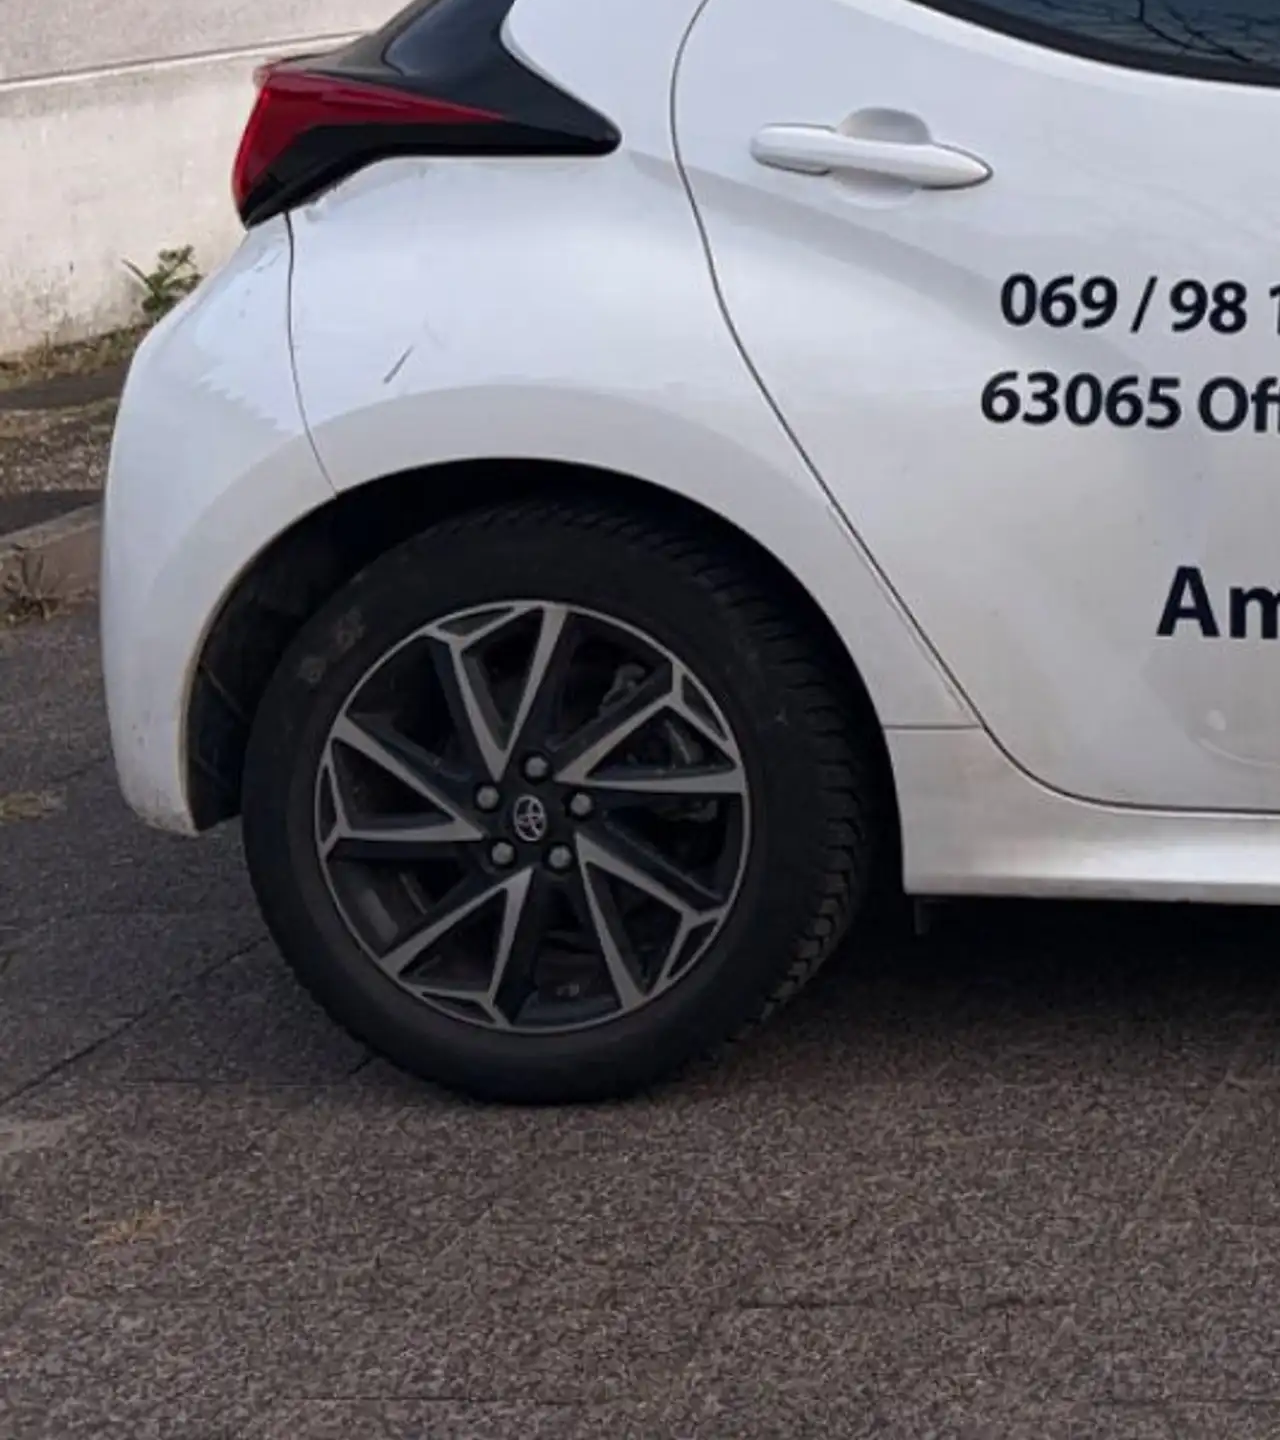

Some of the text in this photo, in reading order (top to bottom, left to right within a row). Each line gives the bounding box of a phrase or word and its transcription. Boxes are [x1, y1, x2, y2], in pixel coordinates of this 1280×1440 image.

[1000, 273, 1118, 329] 069
[1170, 279, 1247, 334] 98
[981, 371, 1182, 430] 63065
